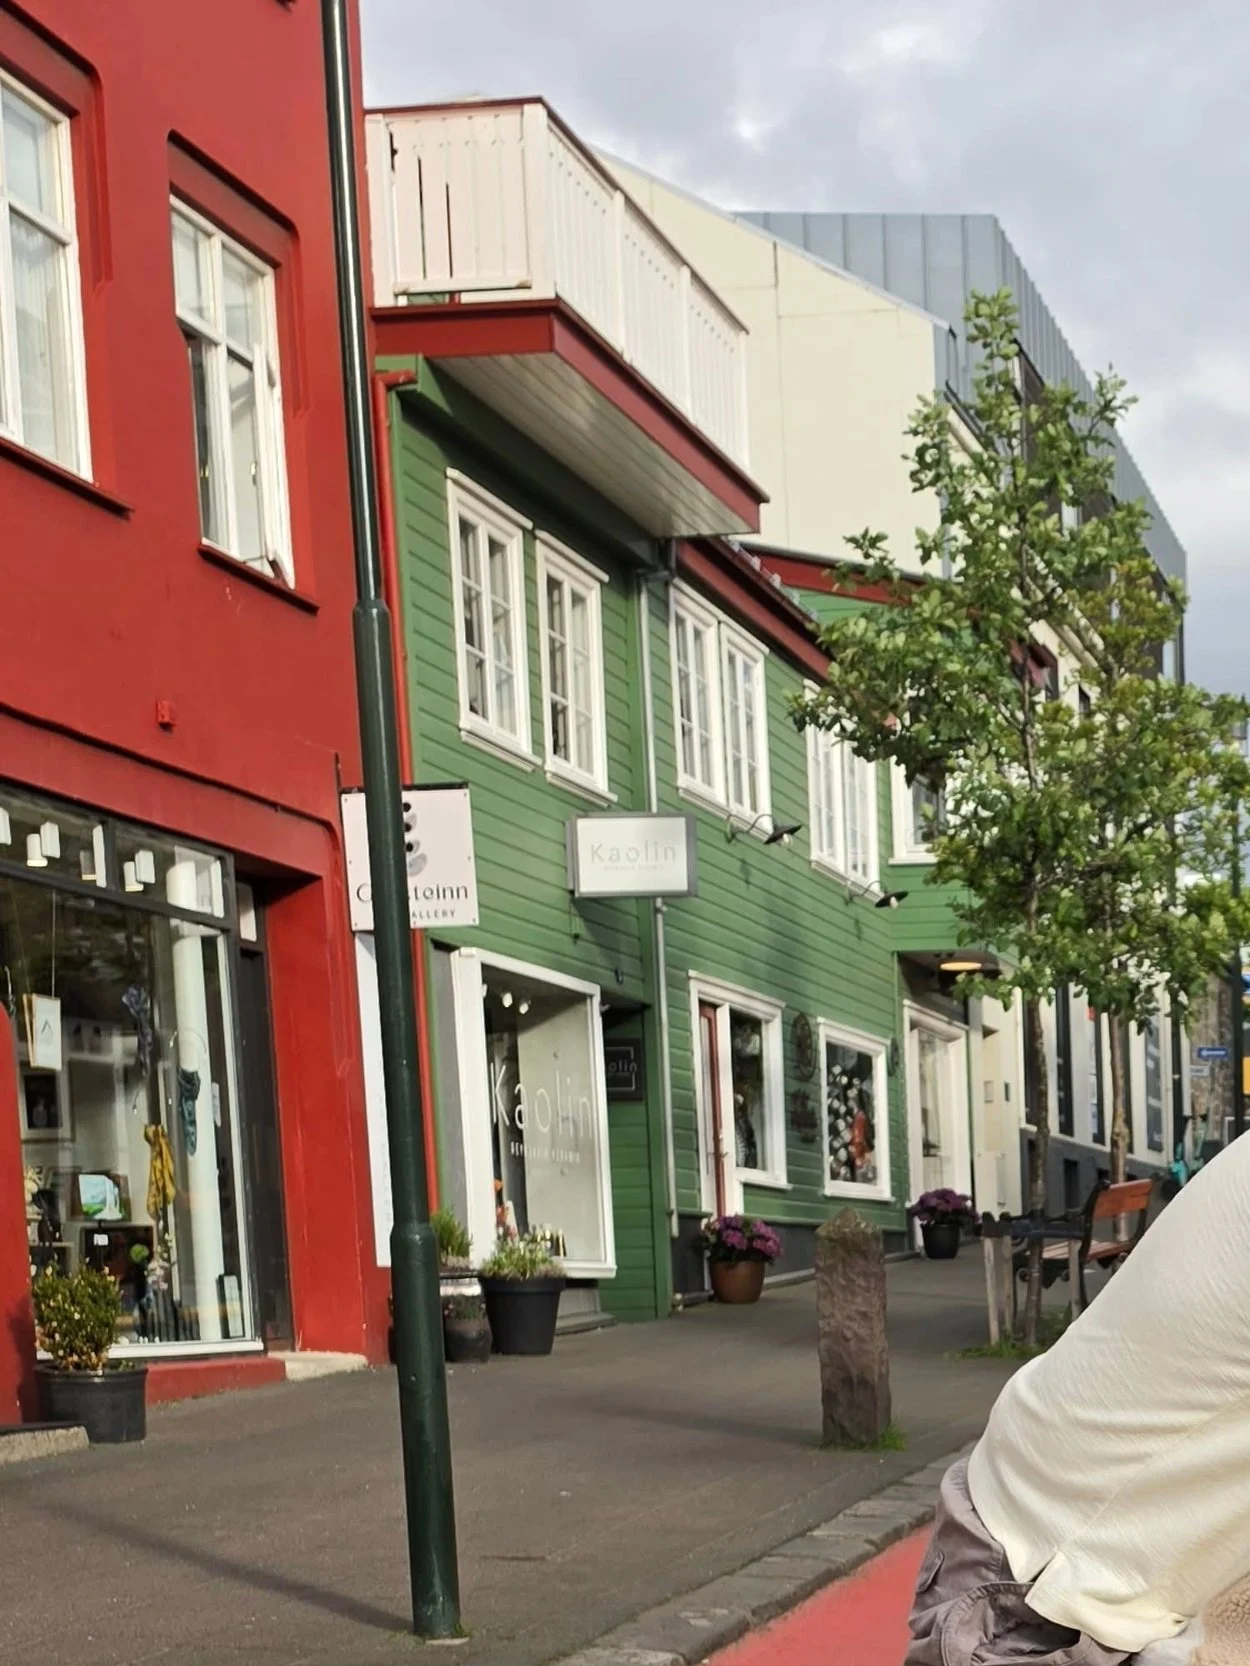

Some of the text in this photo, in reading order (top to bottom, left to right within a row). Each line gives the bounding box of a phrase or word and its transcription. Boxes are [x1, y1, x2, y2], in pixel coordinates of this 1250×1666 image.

[590, 840, 677, 863] Kaolin
[411, 908, 456, 920] ALLERY
[608, 1059, 638, 1073] olin
[490, 1061, 592, 1139] Kaolin
